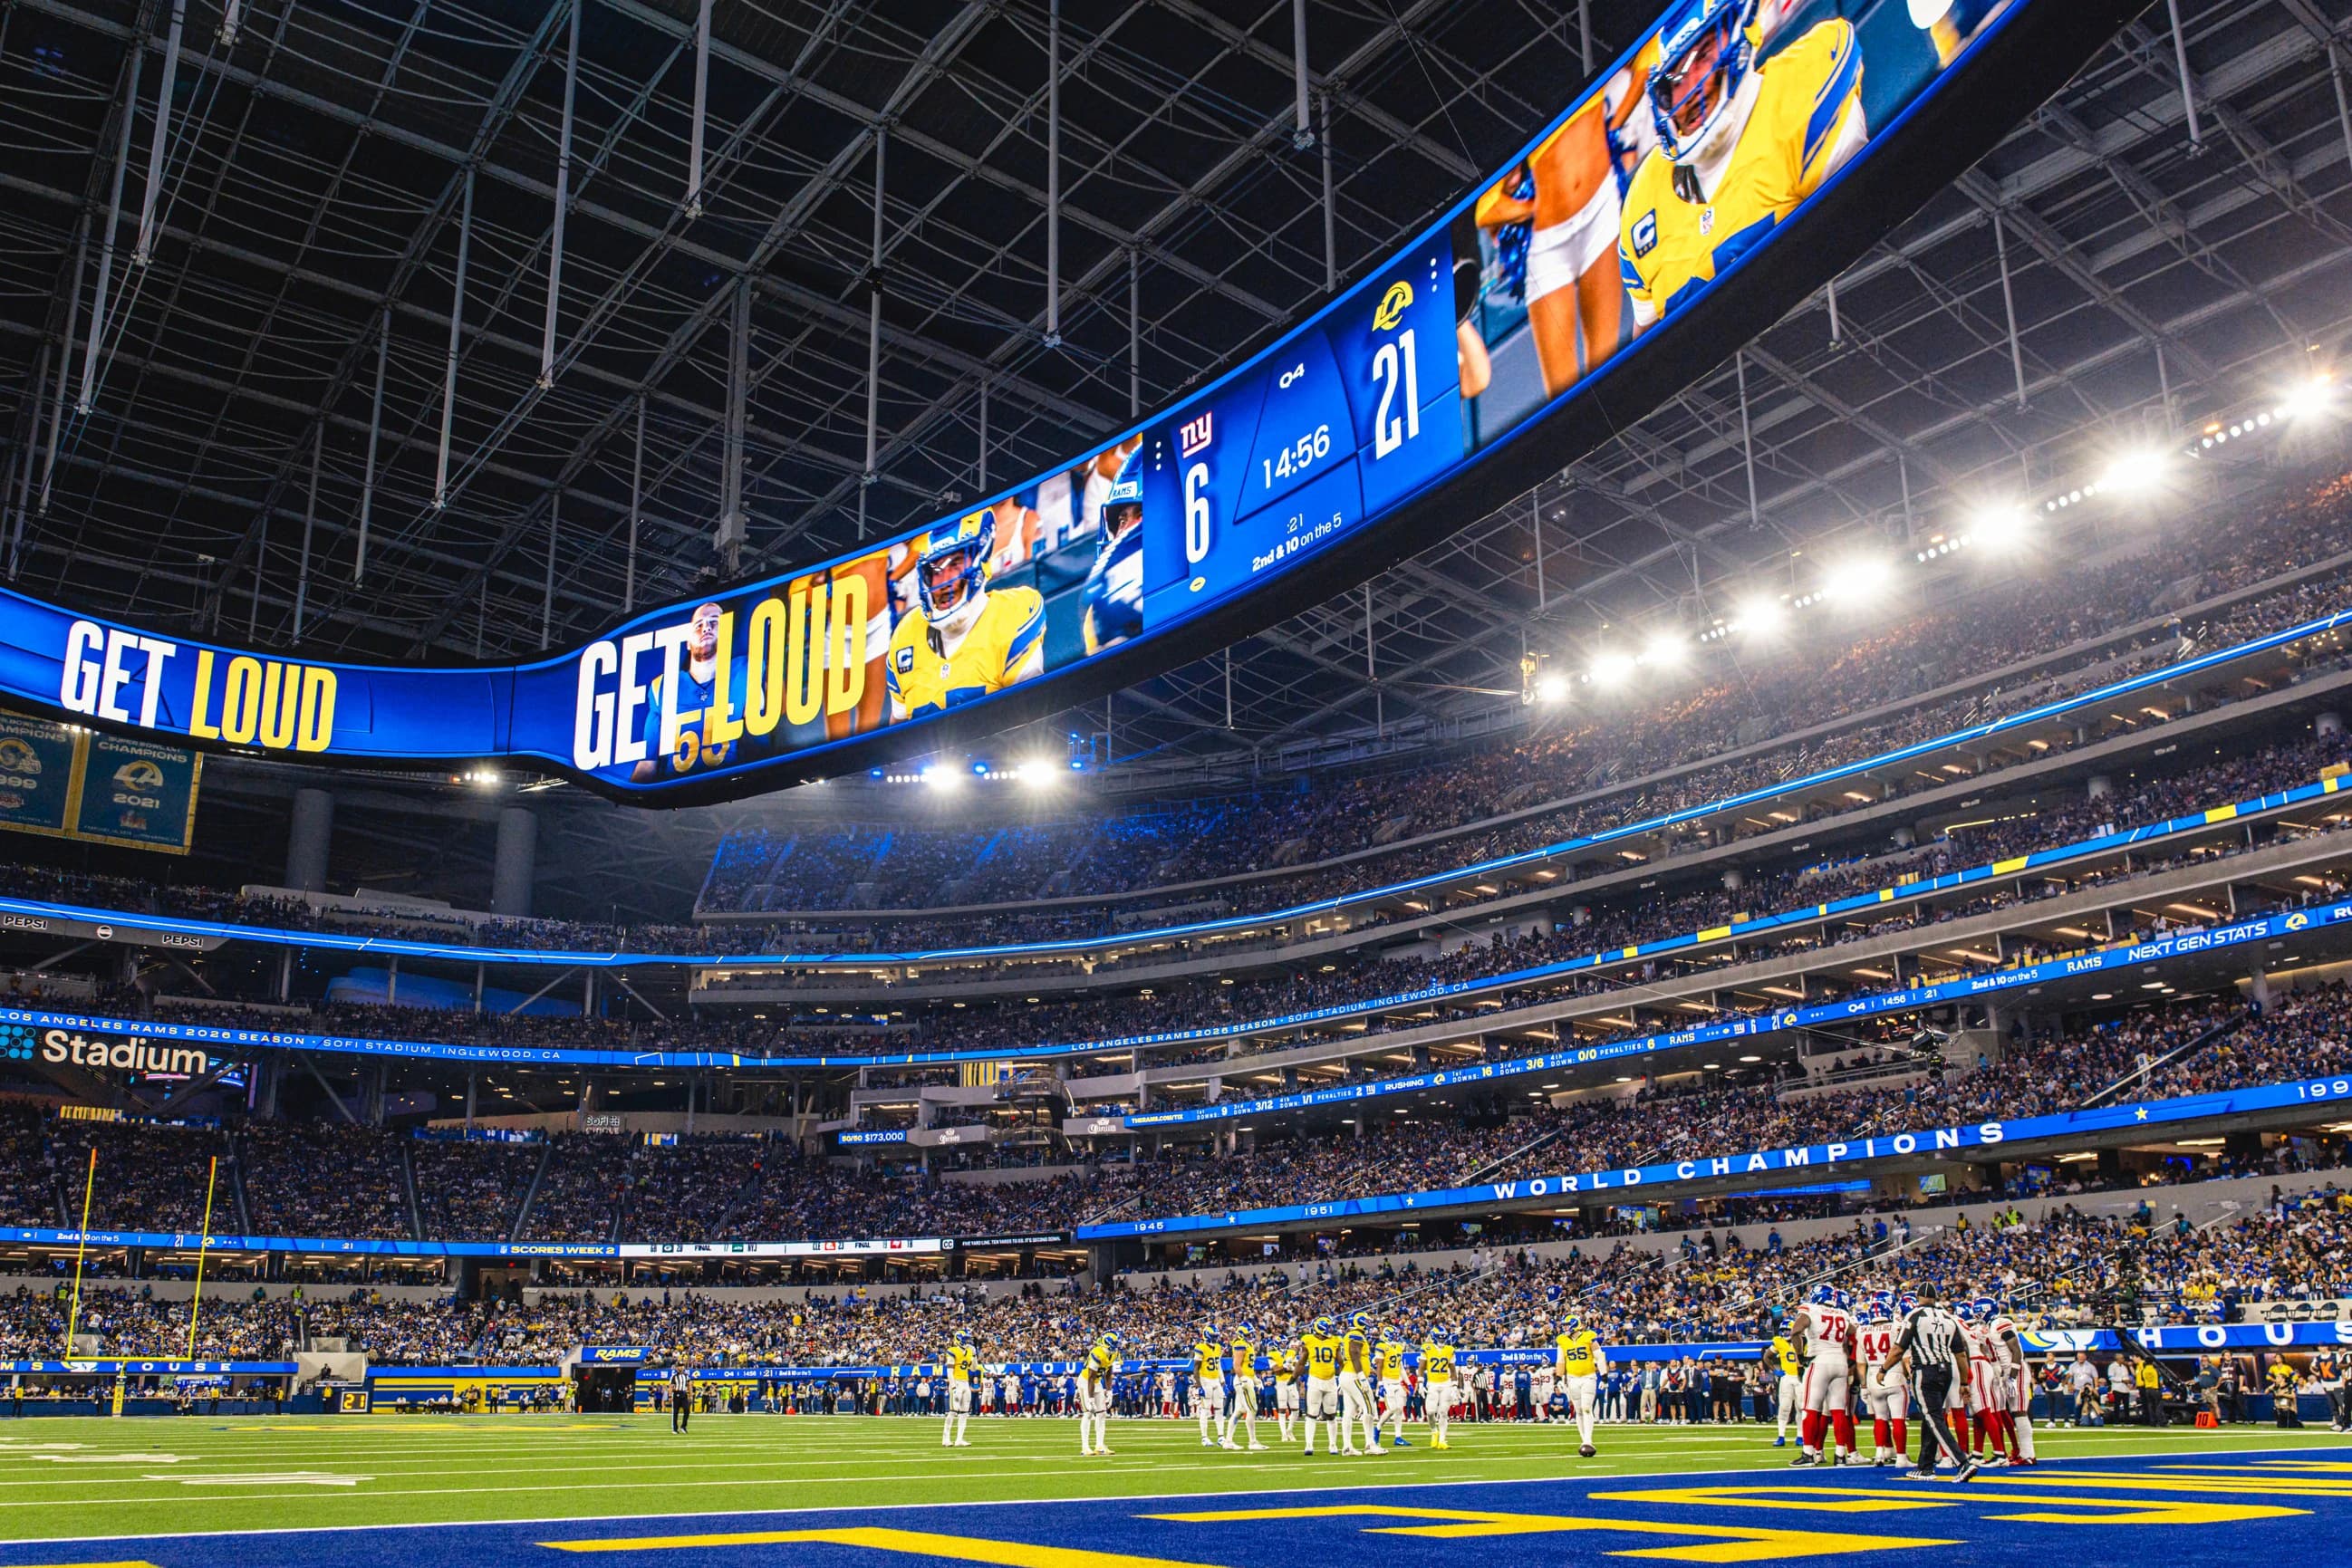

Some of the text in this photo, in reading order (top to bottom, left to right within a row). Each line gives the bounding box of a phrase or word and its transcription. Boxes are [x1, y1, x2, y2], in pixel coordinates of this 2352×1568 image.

[1279, 363, 1305, 389] Q4
[1372, 329, 1420, 460] 21
[1263, 424, 1330, 489] 14:56
[1185, 462, 1210, 563] 6
[1286, 514, 1303, 534] :21
[1252, 513, 1342, 572] 2nd & 10 on the 5
[60, 620, 177, 728] GET
[574, 573, 868, 771] GET LOUD
[188, 649, 338, 753] LOUD
[98, 741, 188, 763] CHAMPIONS
[113, 793, 160, 809] 2021
[4, 916, 48, 929] PEPSI
[162, 934, 204, 948] PEPSI
[2128, 921, 2268, 961] NEXT GEN STATS
[2067, 957, 2103, 973] RAMS
[1847, 1001, 1866, 1014] Q4
[1882, 995, 1906, 1006] 14:56
[1971, 980, 1988, 990] 2nd
[1996, 976, 2006, 986] 10
[2018, 972, 2030, 981] the
[2030, 969, 2038, 979] 5
[1071, 1042, 1094, 1052] LOS
[1098, 1035, 1152, 1049] ANGELES
[1157, 1031, 1190, 1042] RAMS
[1232, 1019, 1277, 1034] SEASON
[1288, 1012, 1313, 1023] SOFI
[1453, 982, 1470, 992] CA
[1771, 1015, 1780, 1030] 21
[1751, 1018, 1757, 1034] 6
[40, 1015, 123, 1030] ANGELES
[130, 1024, 178, 1035] RAMS
[238, 1032, 305, 1045] SEASON
[323, 1038, 359, 1049] SOFI
[542, 1051, 561, 1059] CA
[1669, 1032, 1695, 1044] RAMS
[43, 1029, 207, 1074] Stadium
[1550, 1058, 1576, 1067] DOWN:
[1577, 1048, 1597, 1062] 0/0
[1647, 1038, 1655, 1050] 6
[1481, 1066, 1492, 1077] 16
[1526, 1057, 1545, 1070] 3/6
[1356, 1086, 1363, 1096] 2
[1384, 1079, 1424, 1092] RUSHING
[2299, 1082, 2349, 1099] 199
[1221, 1108, 1229, 1116] 9
[1256, 1099, 1274, 1111] 3/12
[864, 1132, 904, 1142] $173,000
[1494, 1122, 2004, 1200] WORLD CHAMPIONS
[1305, 1206, 1334, 1217] 1951
[1134, 1222, 1164, 1232] 1945
[174, 1235, 184, 1247] 21
[511, 1246, 564, 1255] SCORES
[565, 1246, 604, 1255] WEEK
[1819, 1315, 1846, 1342] 78
[1314, 1346, 1333, 1363] 10
[1566, 1346, 1588, 1361] 55
[1864, 1332, 1891, 1361] 44
[594, 1349, 642, 1361] RAMS
[1501, 1353, 1514, 1361] 2nd
[1519, 1352, 1527, 1361] 10
[116, 1361, 231, 1371] HOUSE
[891, 1364, 943, 1377] RAM
[1021, 1361, 1122, 1375] HOUE
[1430, 1357, 1449, 1373] 22
[2319, 1361, 2337, 1380] K
[1504, 1380, 1513, 1390] 26
[1541, 1375, 1550, 1384] 23
[343, 1393, 366, 1409] 21
[2197, 1412, 2209, 1428] 10
